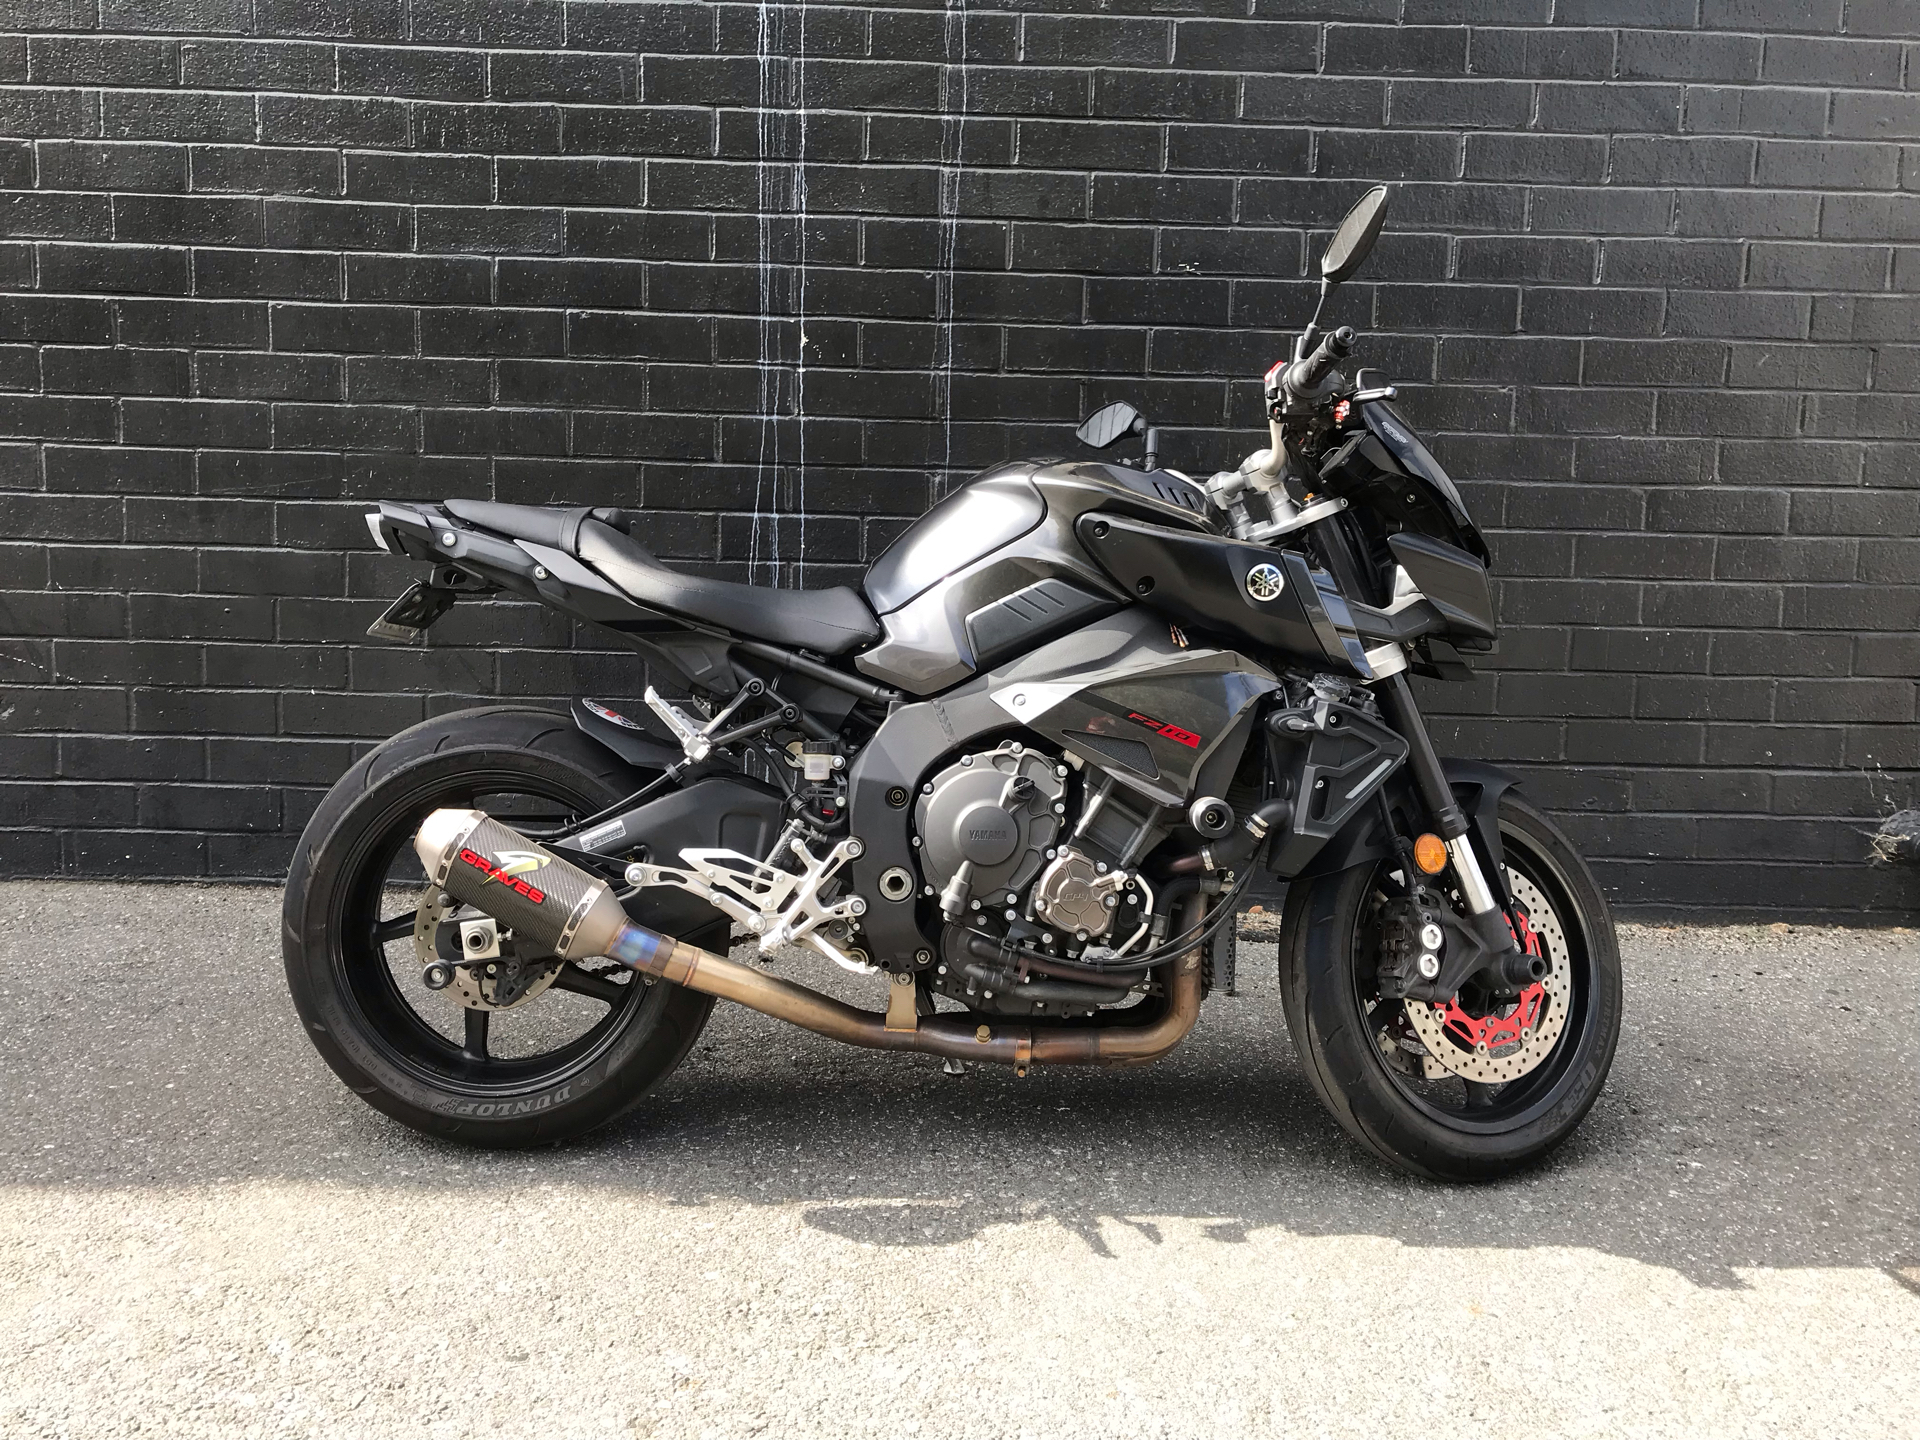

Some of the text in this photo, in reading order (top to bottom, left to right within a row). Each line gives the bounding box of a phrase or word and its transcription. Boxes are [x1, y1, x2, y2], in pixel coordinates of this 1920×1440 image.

[969, 829, 1007, 842] YAMAHA
[458, 848, 546, 904] GRAVES
[1596, 976, 1613, 1058] SPORTMAX
[456, 1085, 571, 1117] DUNLOP
